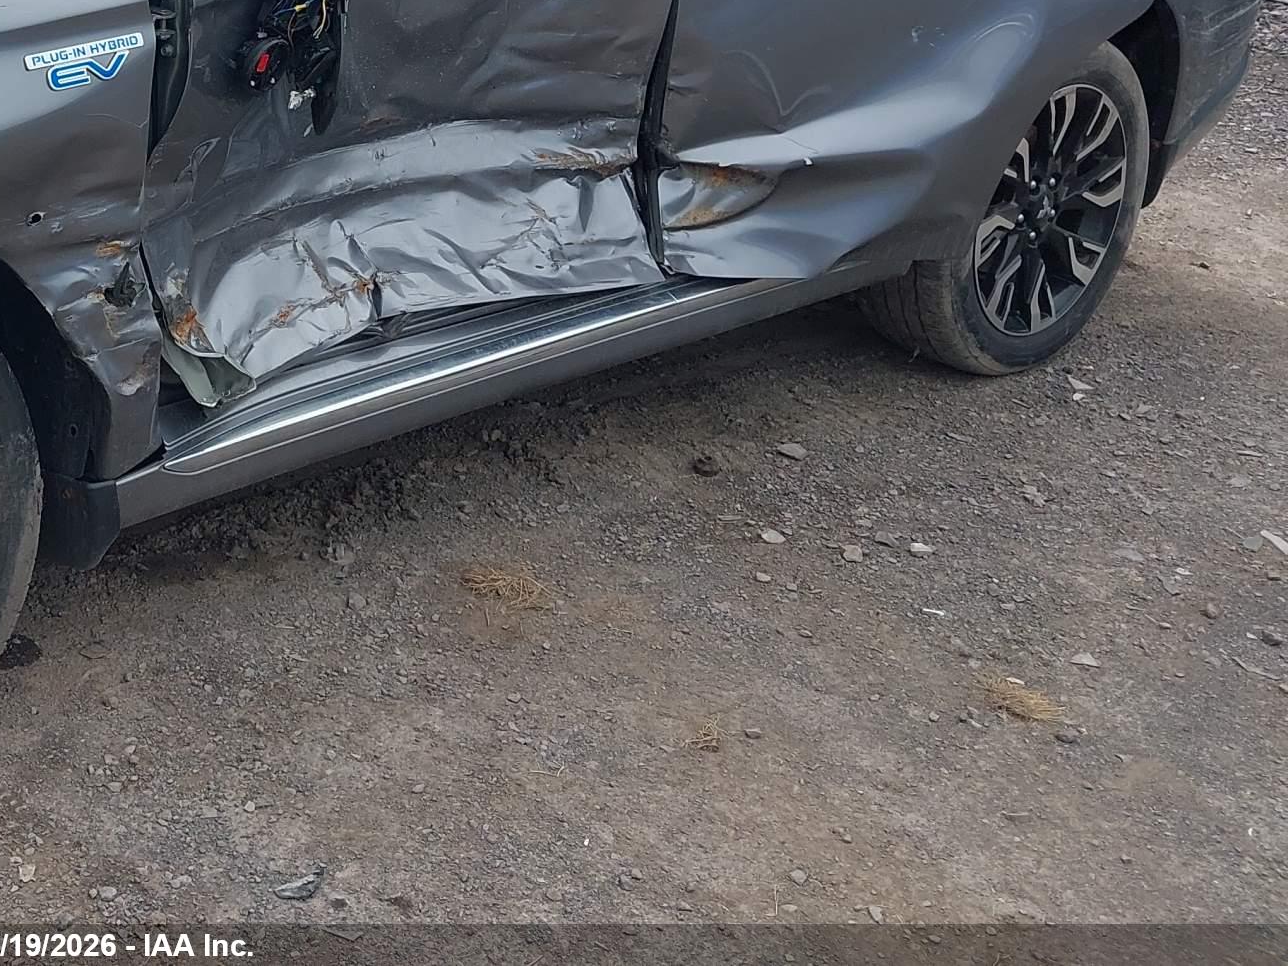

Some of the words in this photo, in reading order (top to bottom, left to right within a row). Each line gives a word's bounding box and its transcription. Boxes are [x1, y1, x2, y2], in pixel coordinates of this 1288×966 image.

[31, 46, 86, 67] PLUG-IN
[89, 34, 139, 55] HYBRID
[50, 52, 125, 89] EV
